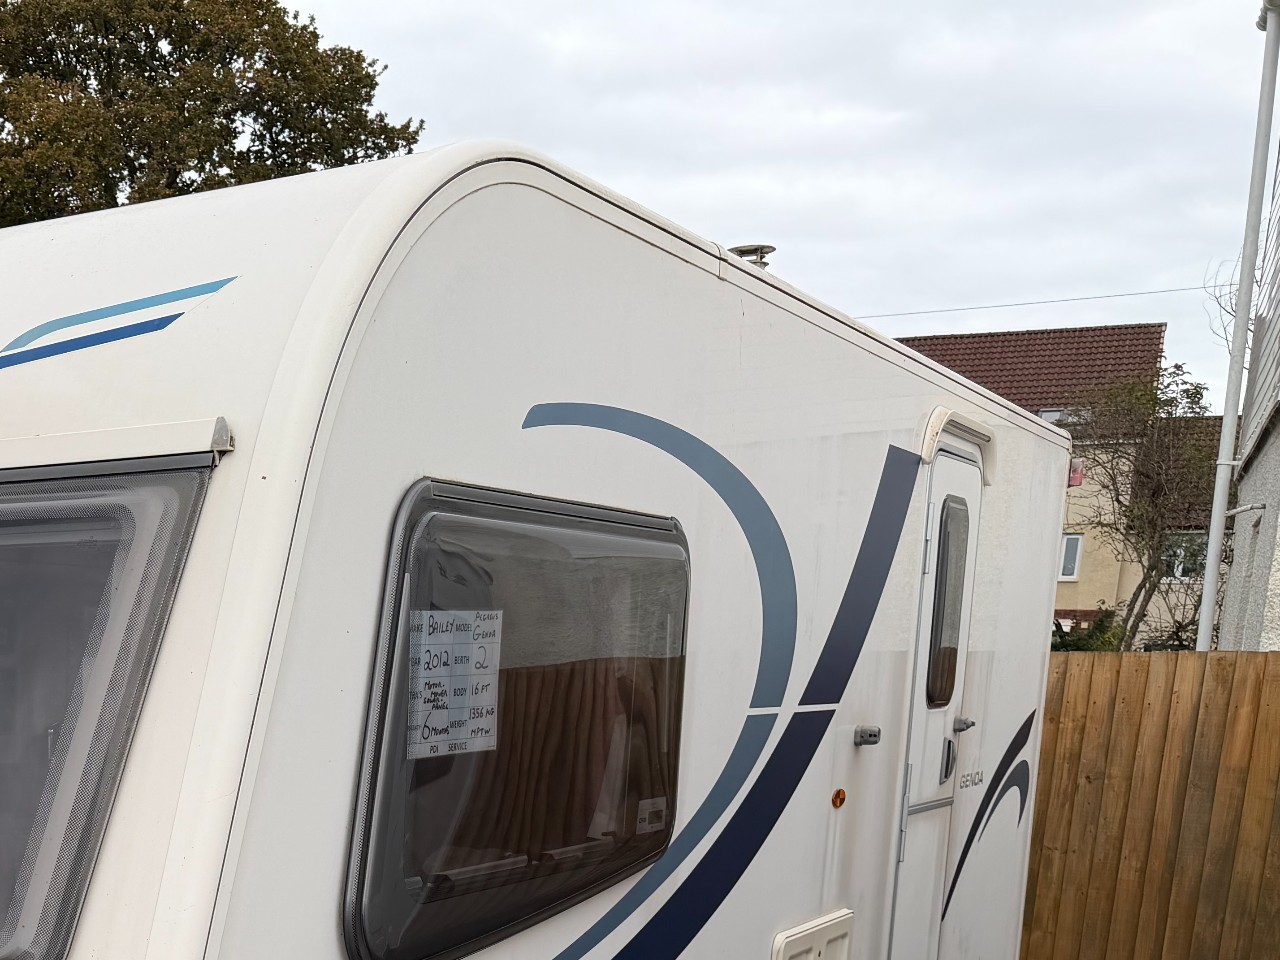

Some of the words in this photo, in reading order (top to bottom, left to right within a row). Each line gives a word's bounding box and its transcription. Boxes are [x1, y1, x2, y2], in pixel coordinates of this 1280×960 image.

[428, 615, 456, 636] BAILEY
[423, 649, 451, 671] 2012
[454, 656, 470, 665] BERTH
[474, 645, 489, 670] 2
[453, 687, 468, 697] BODY
